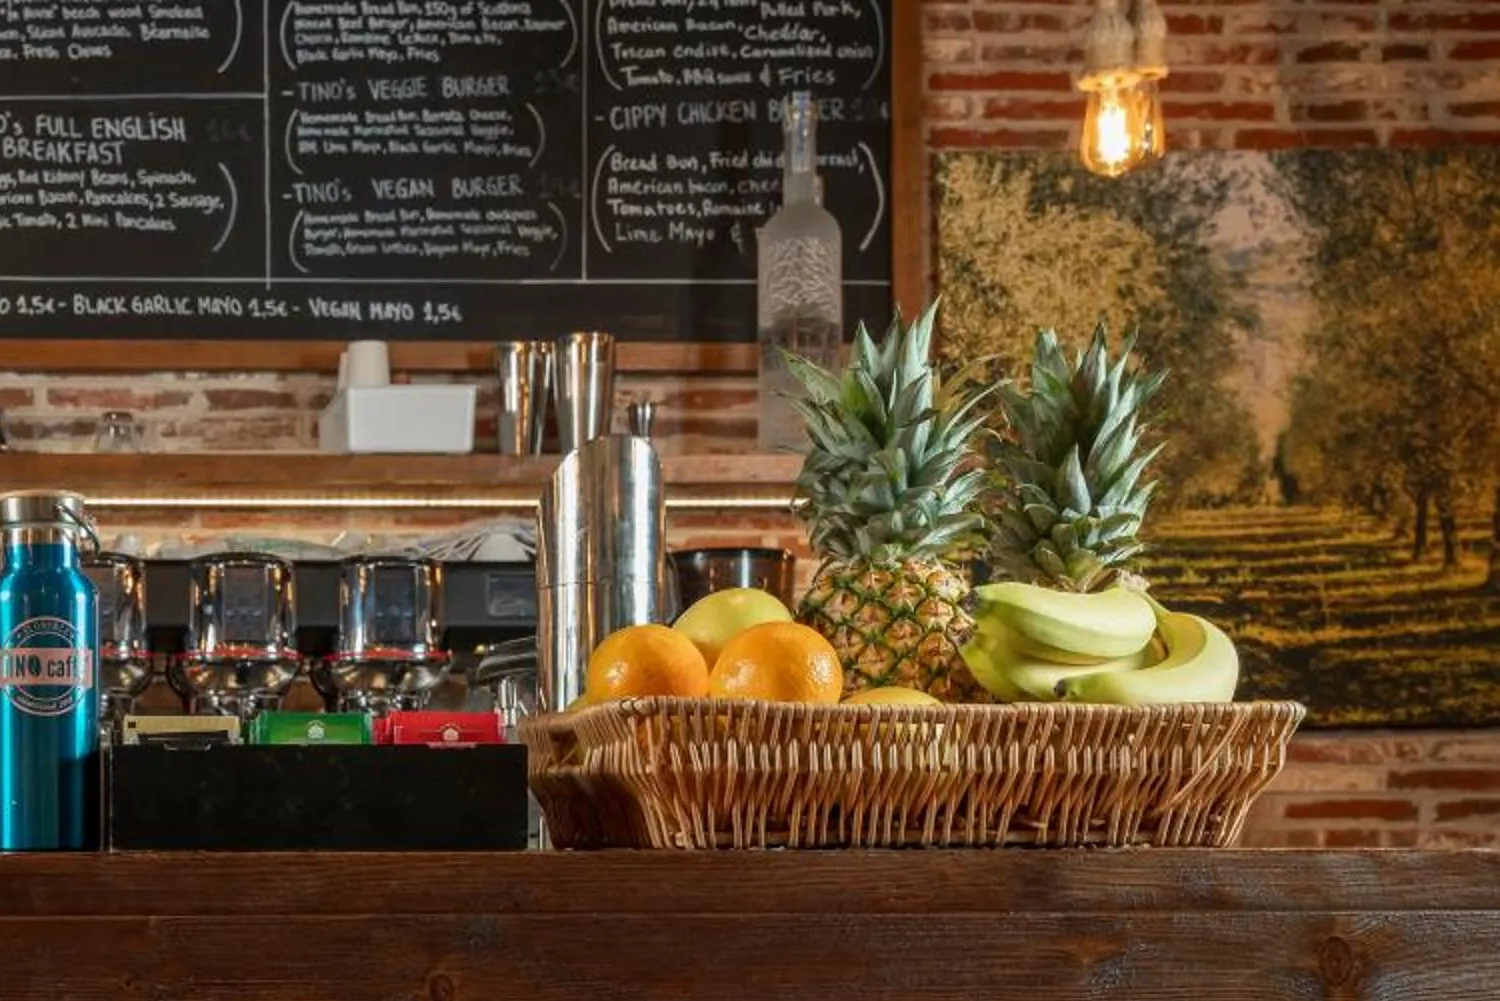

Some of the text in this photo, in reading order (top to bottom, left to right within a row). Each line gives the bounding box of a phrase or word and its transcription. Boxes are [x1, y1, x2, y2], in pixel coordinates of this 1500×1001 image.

[366, 75, 428, 100] VEGGIE
[441, 74, 510, 99] BURGER
[776, 66, 836, 86] Fries
[34, 114, 83, 139] FULL
[90, 111, 187, 143] ENGLISH
[608, 103, 668, 131] CIPPY
[676, 99, 758, 125] CHICKEN
[2, 137, 125, 165] BREAKFAST
[610, 151, 658, 173] Bread
[371, 177, 436, 201] VEGAN
[451, 173, 524, 200] BURGER
[607, 177, 685, 196] American
[615, 223, 663, 242] Lime
[72, 293, 129, 316] BLACK
[130, 293, 193, 316] GARLIC
[197, 296, 243, 317] MAYO
[307, 297, 363, 322] VEGAN
[368, 302, 416, 322] MAYO
